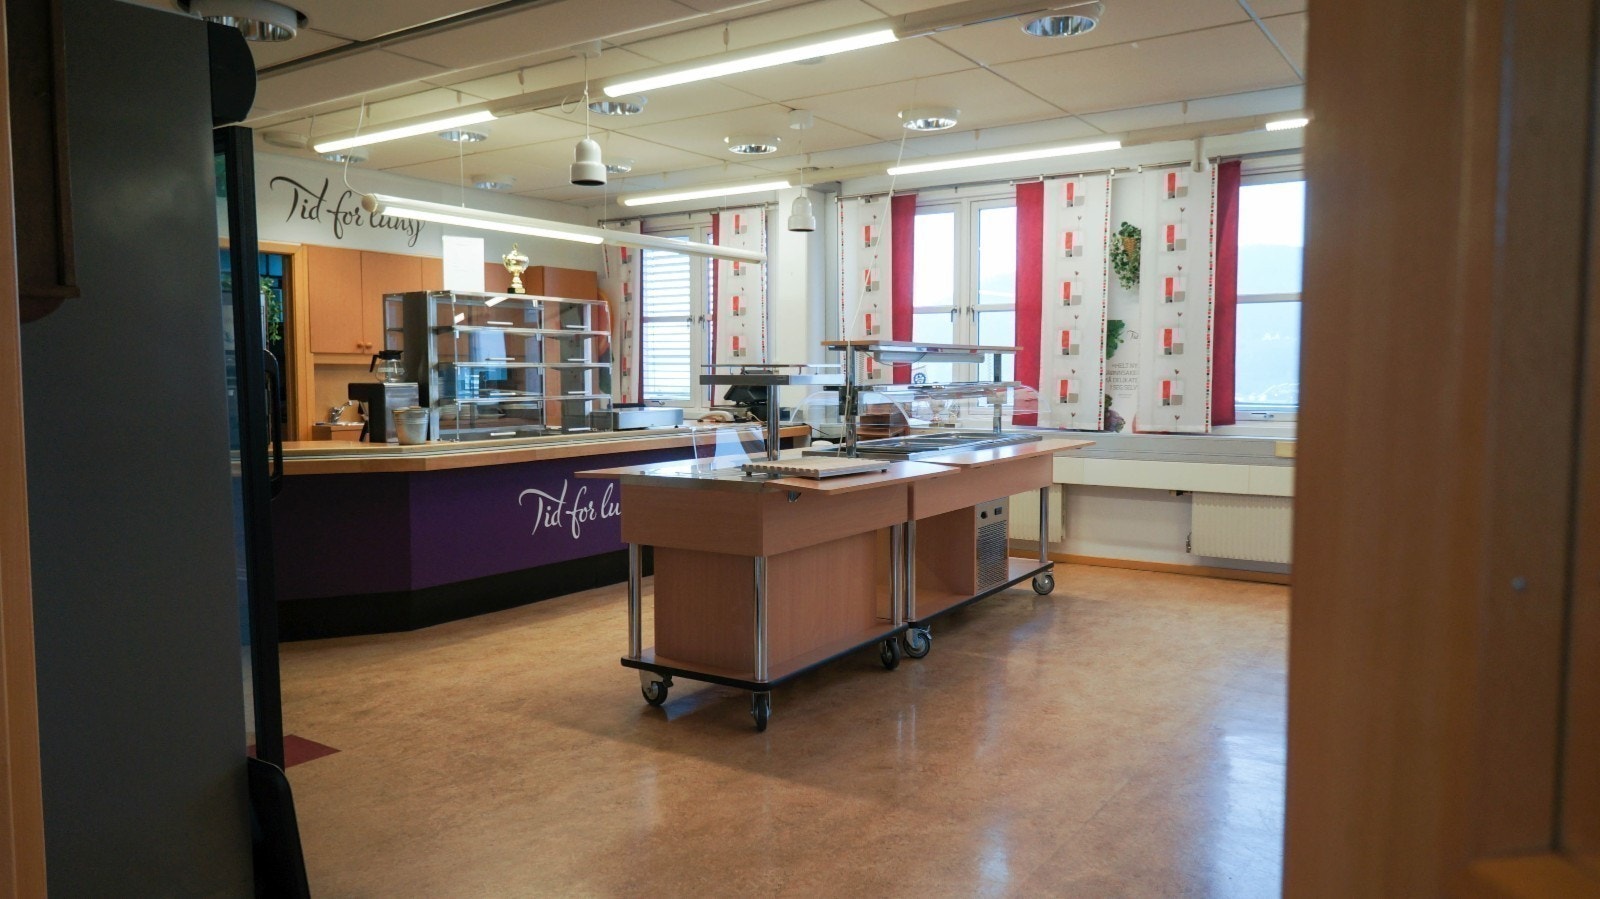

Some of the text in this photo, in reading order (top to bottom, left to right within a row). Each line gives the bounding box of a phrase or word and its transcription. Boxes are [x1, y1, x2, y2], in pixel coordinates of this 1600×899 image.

[269, 176, 328, 223] Tid
[326, 190, 363, 239] for
[519, 479, 567, 535] Tid
[565, 486, 597, 539] for
